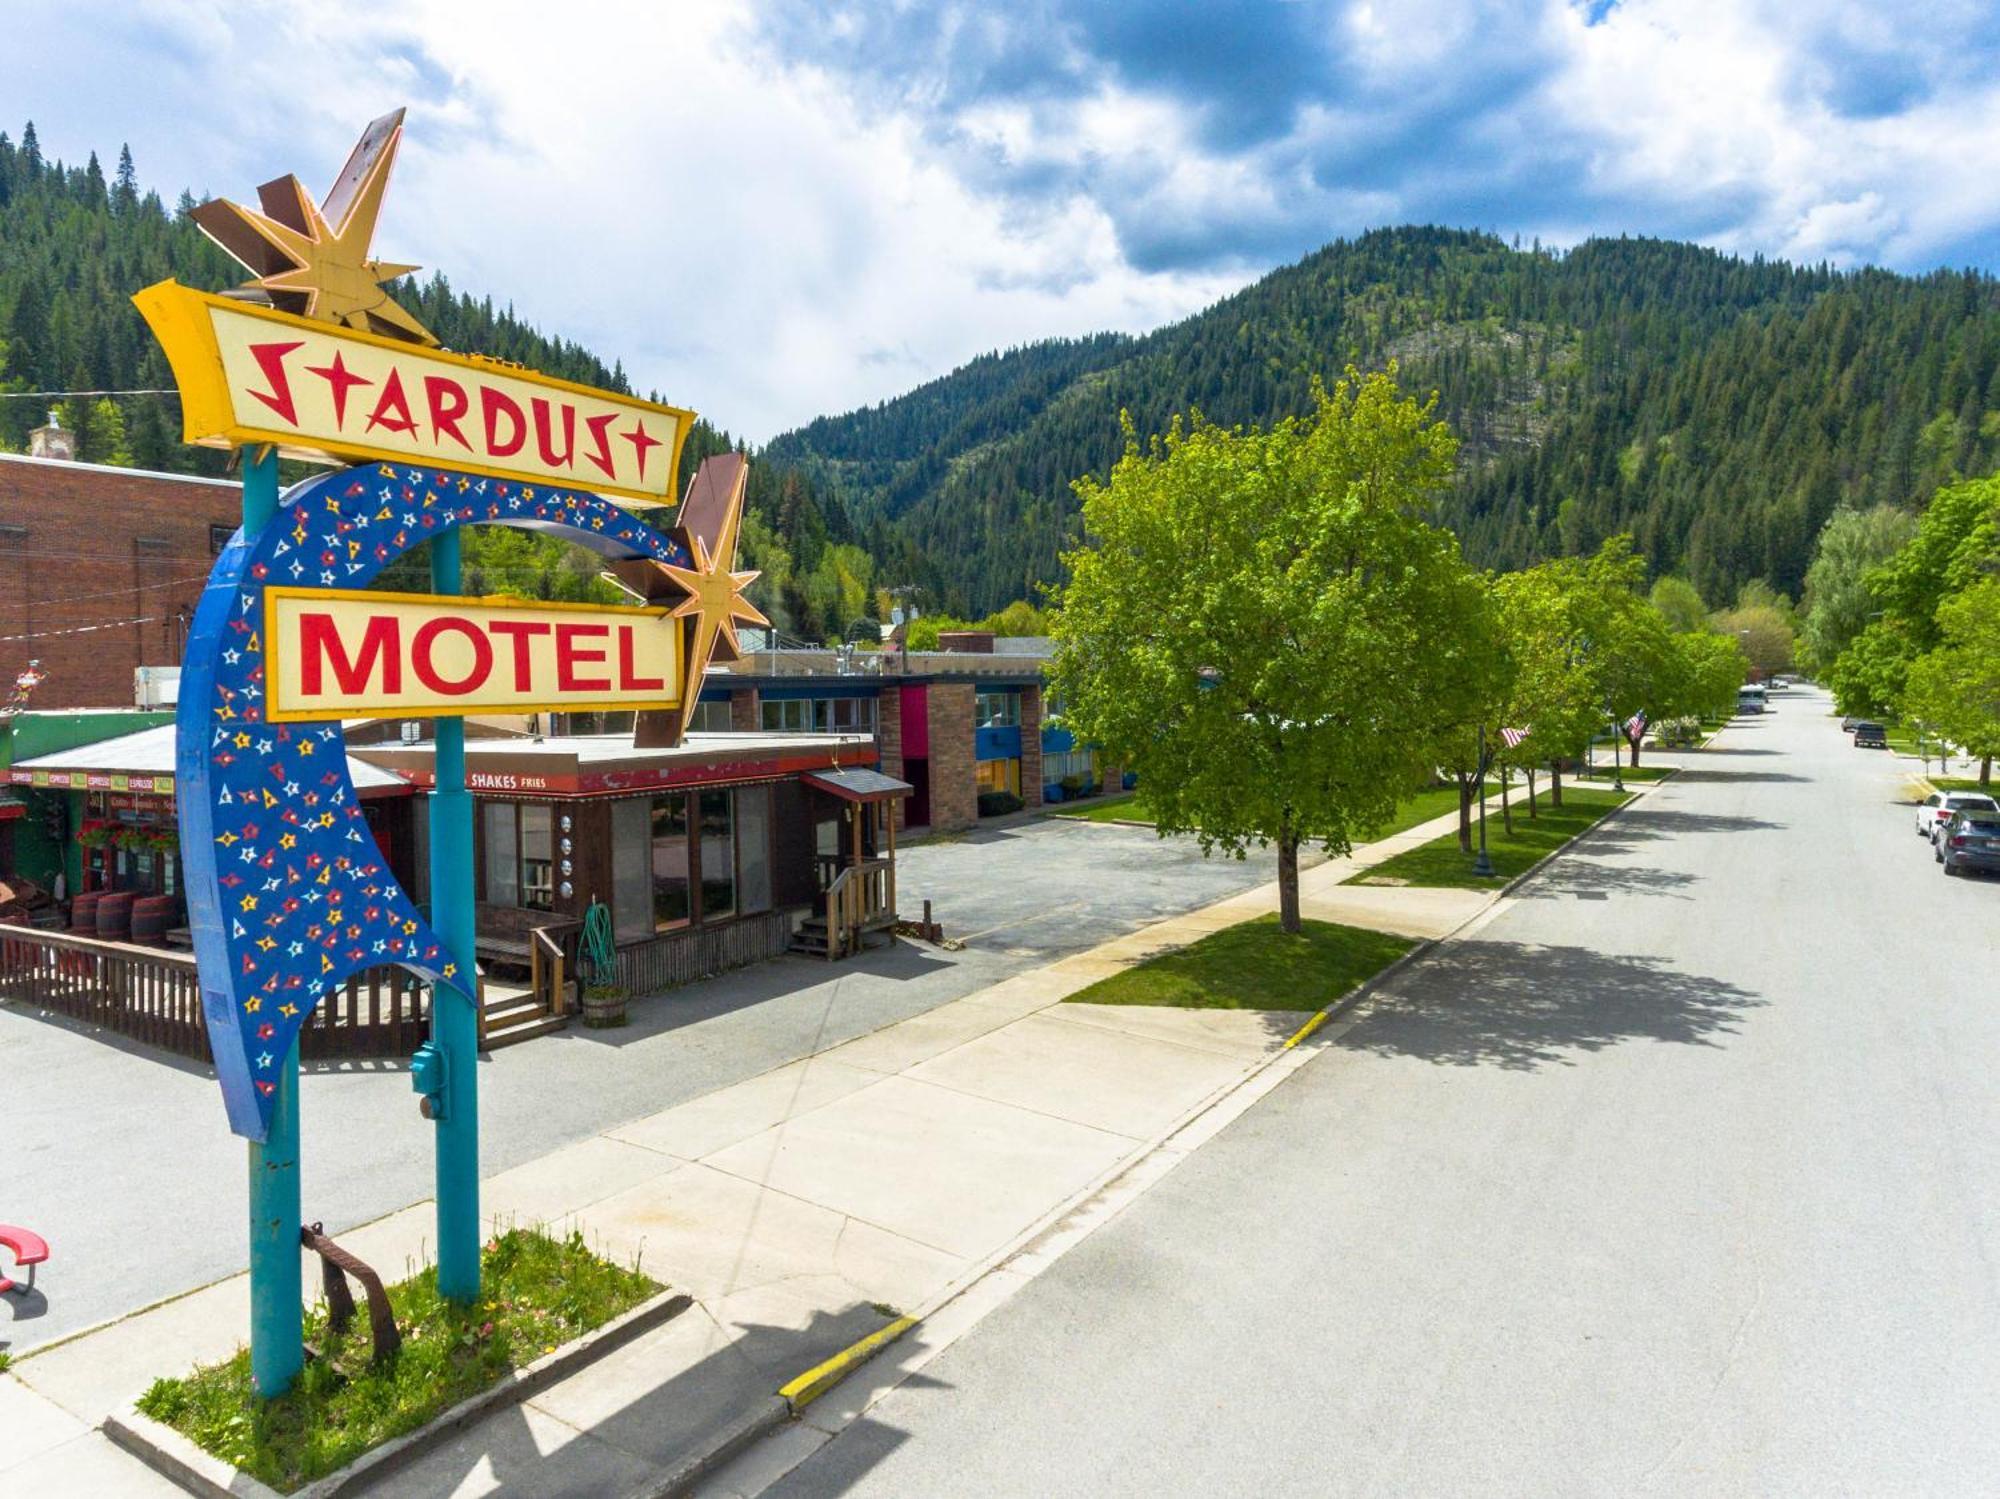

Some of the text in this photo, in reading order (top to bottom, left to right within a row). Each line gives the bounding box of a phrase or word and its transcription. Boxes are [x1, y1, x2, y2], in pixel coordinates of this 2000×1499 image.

[246, 341, 662, 483] STARDUST
[300, 613, 664, 696] MOTEL
[471, 773, 517, 789] SHAKES
[520, 777, 546, 789] FRIES
